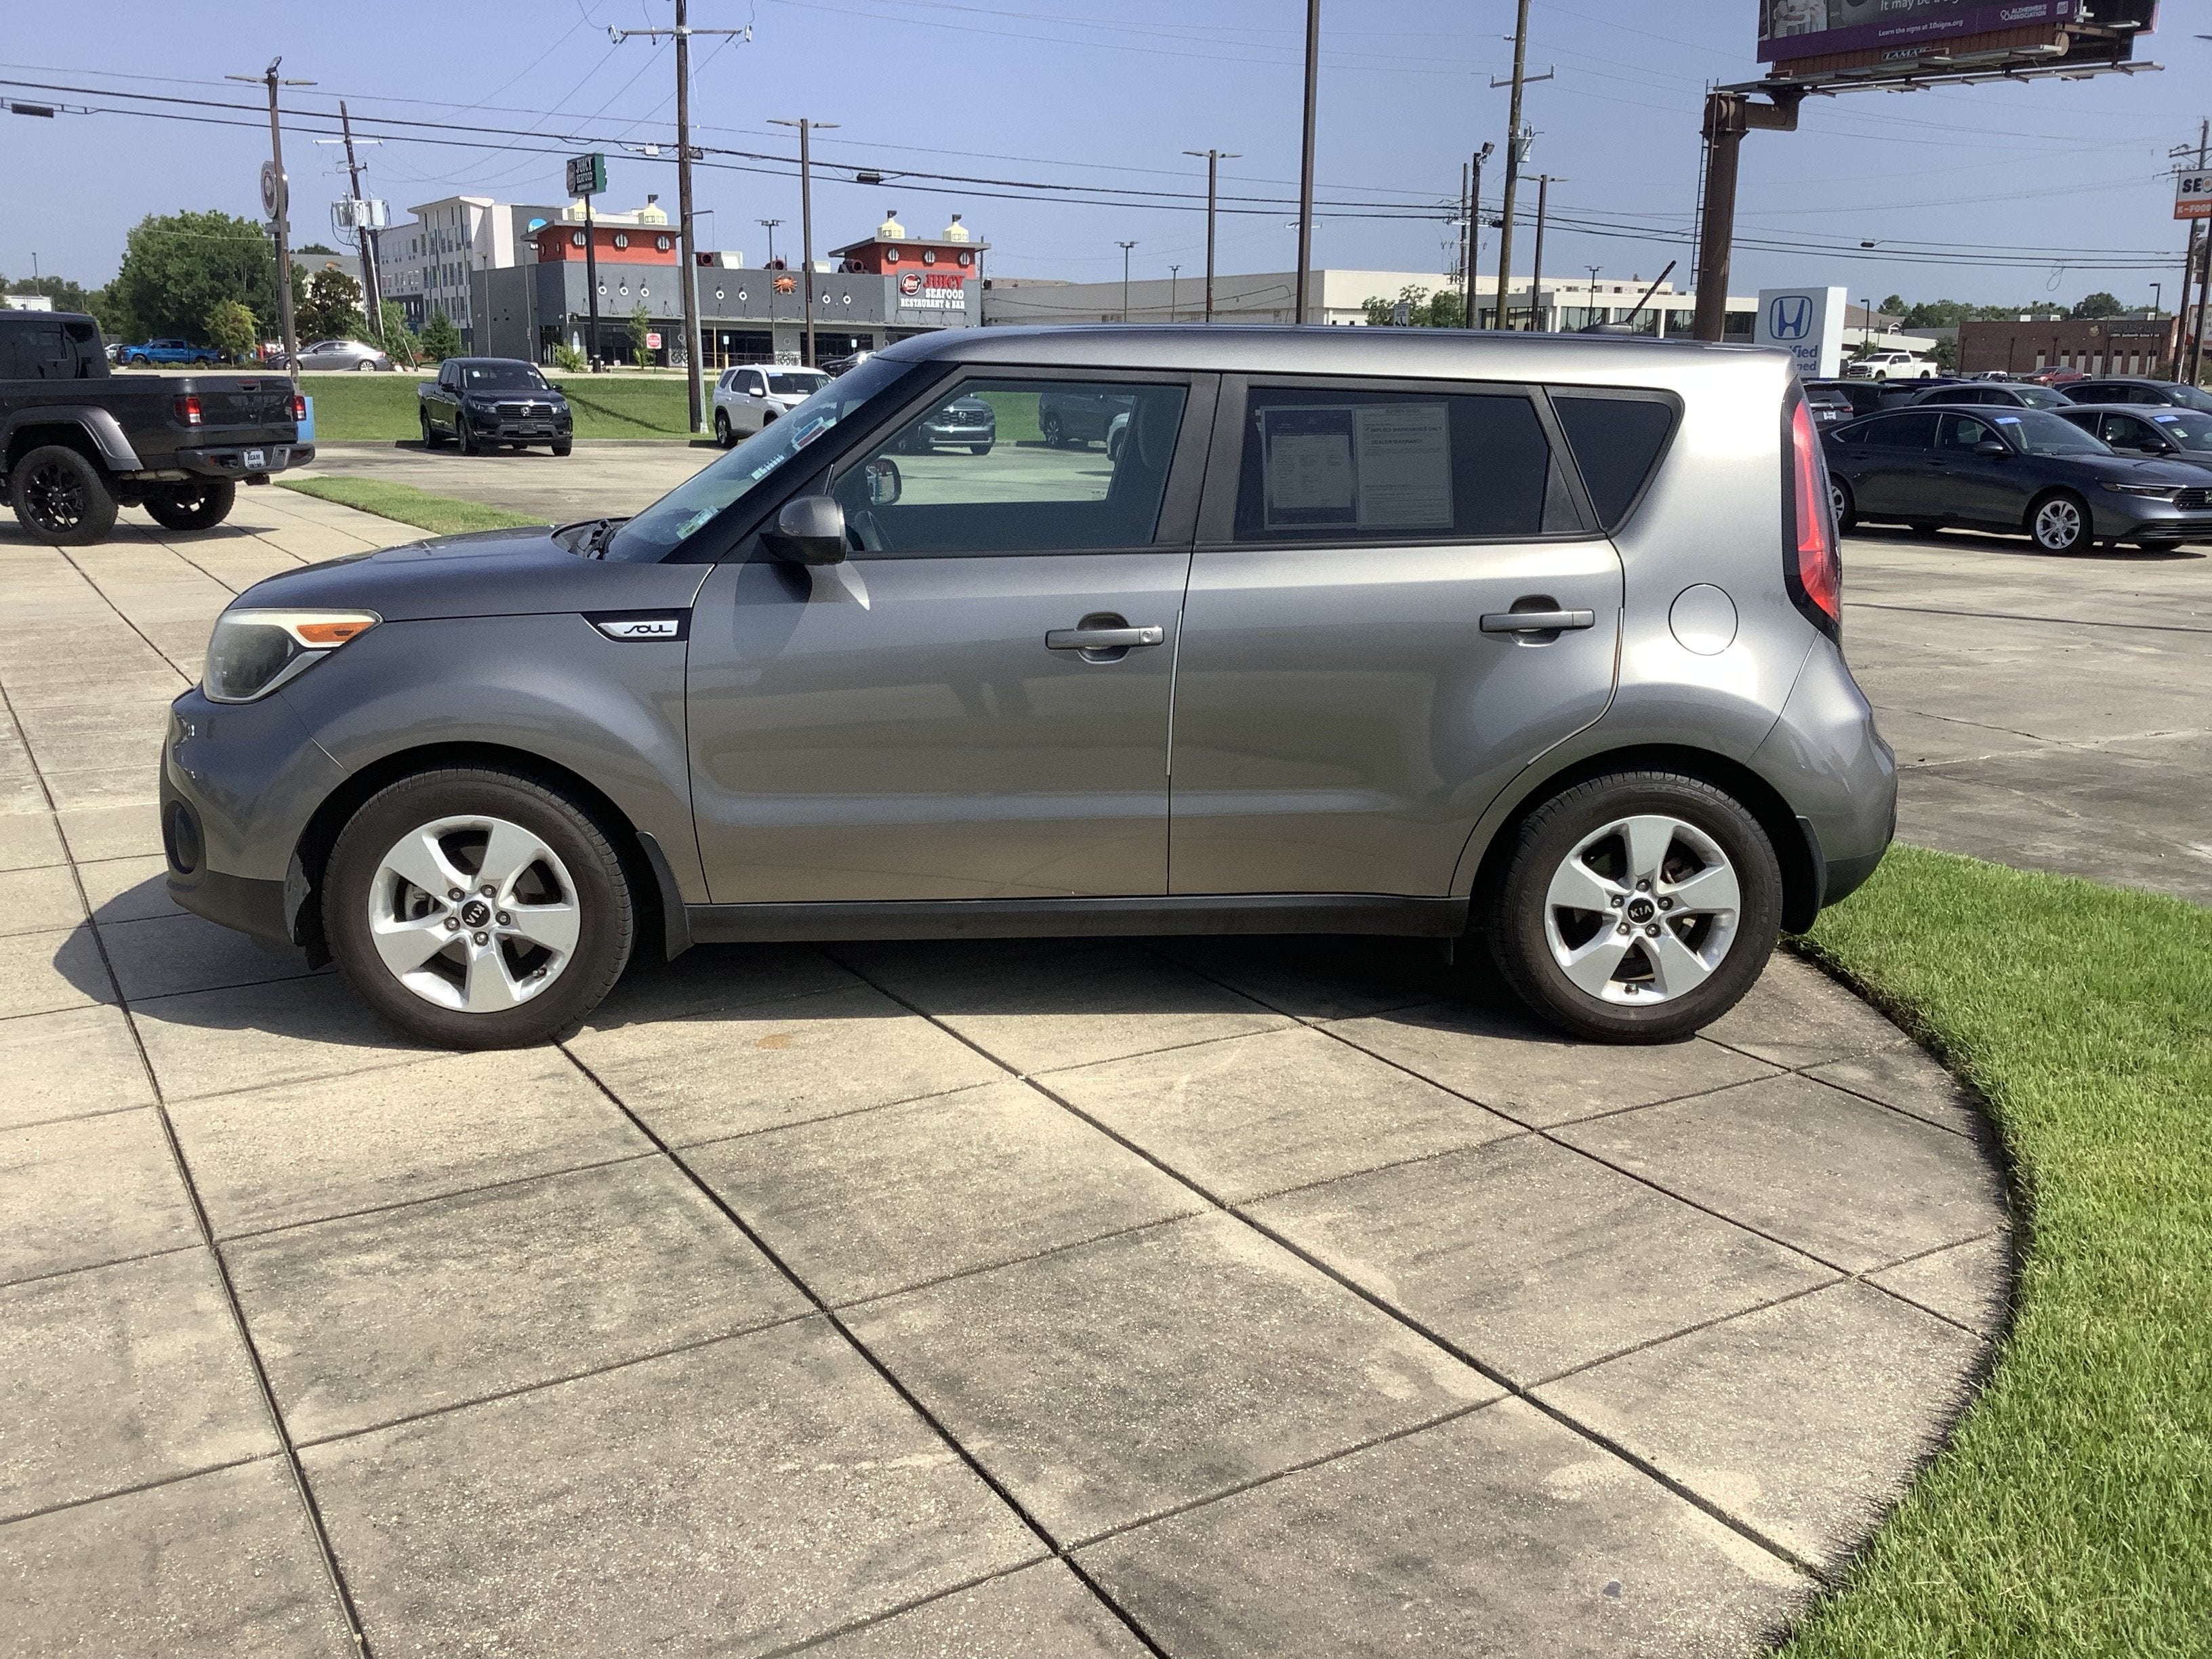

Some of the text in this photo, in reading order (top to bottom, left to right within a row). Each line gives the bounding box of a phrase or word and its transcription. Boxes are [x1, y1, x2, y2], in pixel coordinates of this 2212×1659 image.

[1891, 0, 1914, 11] may
[1906, 25, 1921, 34] signs
[576, 157, 593, 174] JUICY
[923, 274, 964, 289] JUICY
[925, 288, 964, 300] SEAFOOD
[900, 298, 965, 310] RESTAURANT & BAR
[466, 903, 485, 924] KIA
[1630, 905, 1652, 918] KIA
